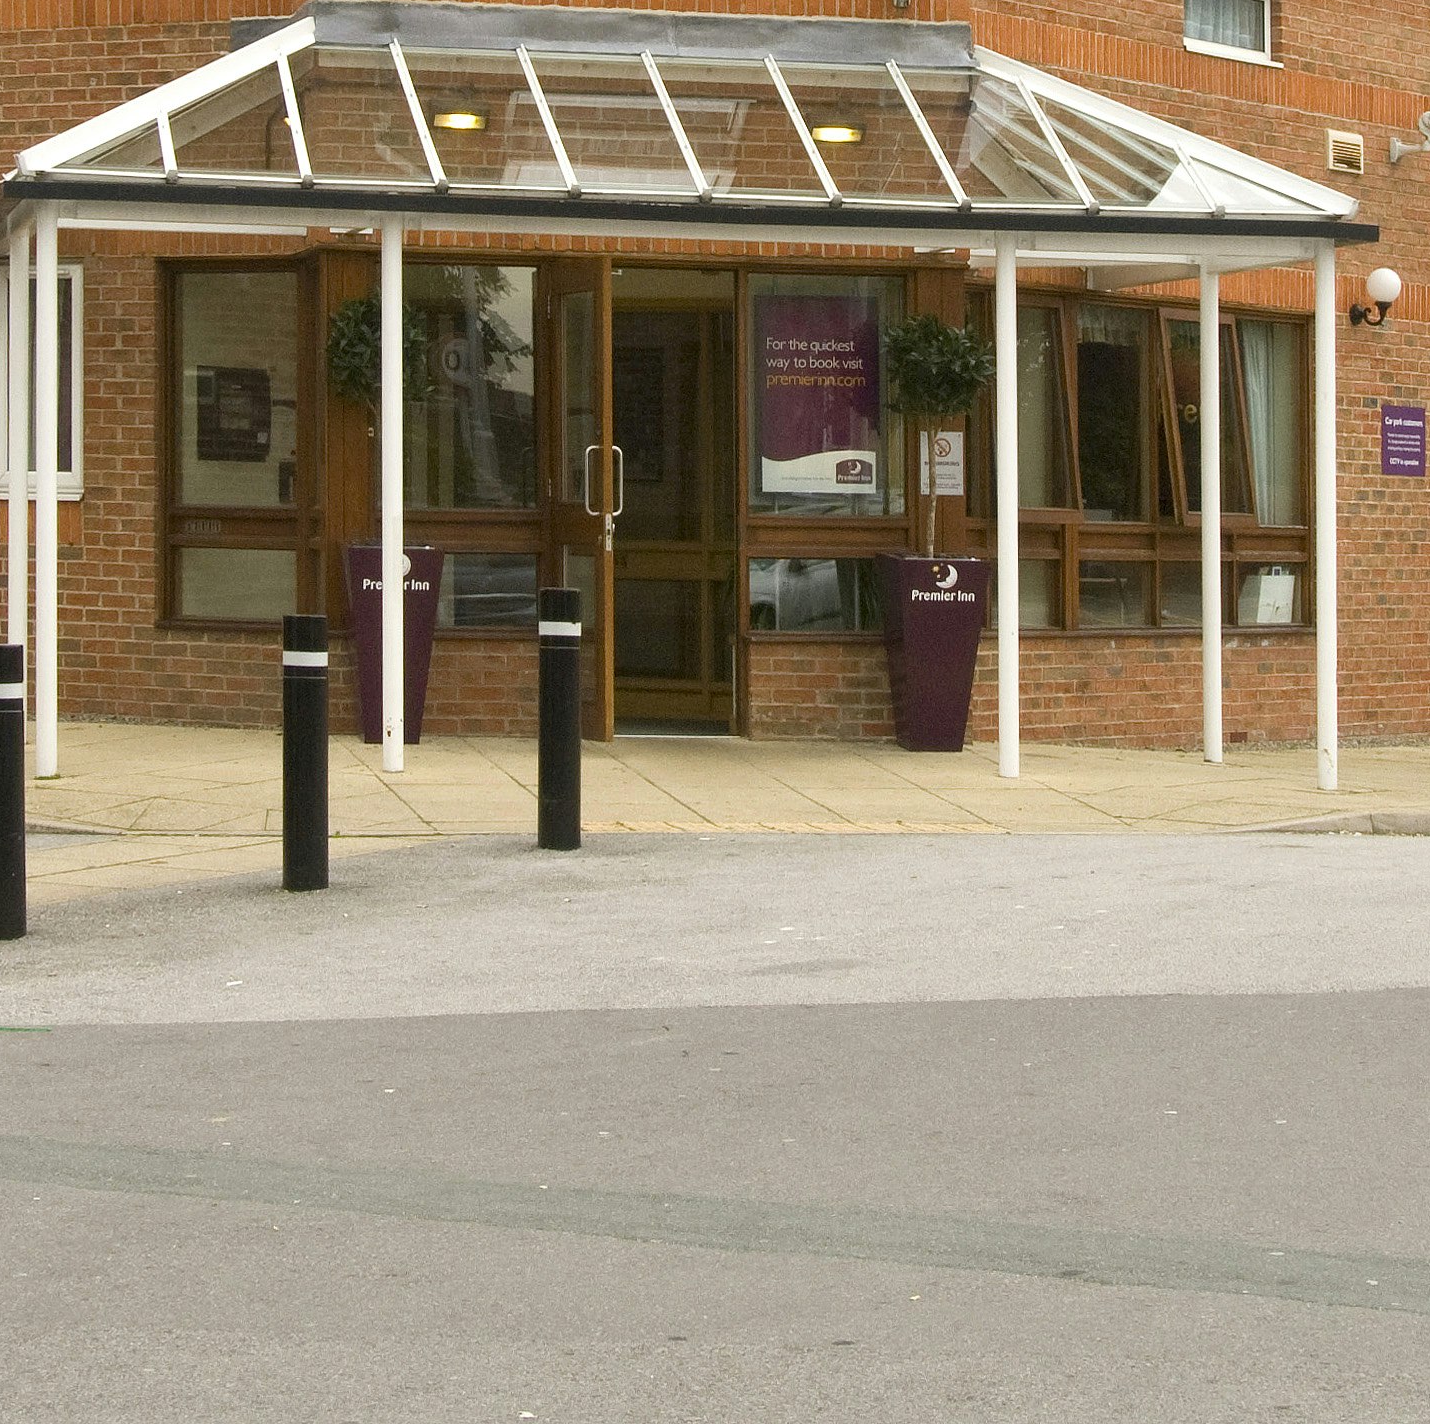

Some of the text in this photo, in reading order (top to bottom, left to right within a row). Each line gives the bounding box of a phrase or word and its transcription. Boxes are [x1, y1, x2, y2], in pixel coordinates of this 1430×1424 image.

[766, 337, 855, 354] For the quickest
[766, 356, 863, 371] way to book visit
[766, 372, 866, 388] premierinn.com
[363, 578, 430, 591] Prer Inn
[911, 589, 976, 602] Premier Inn
